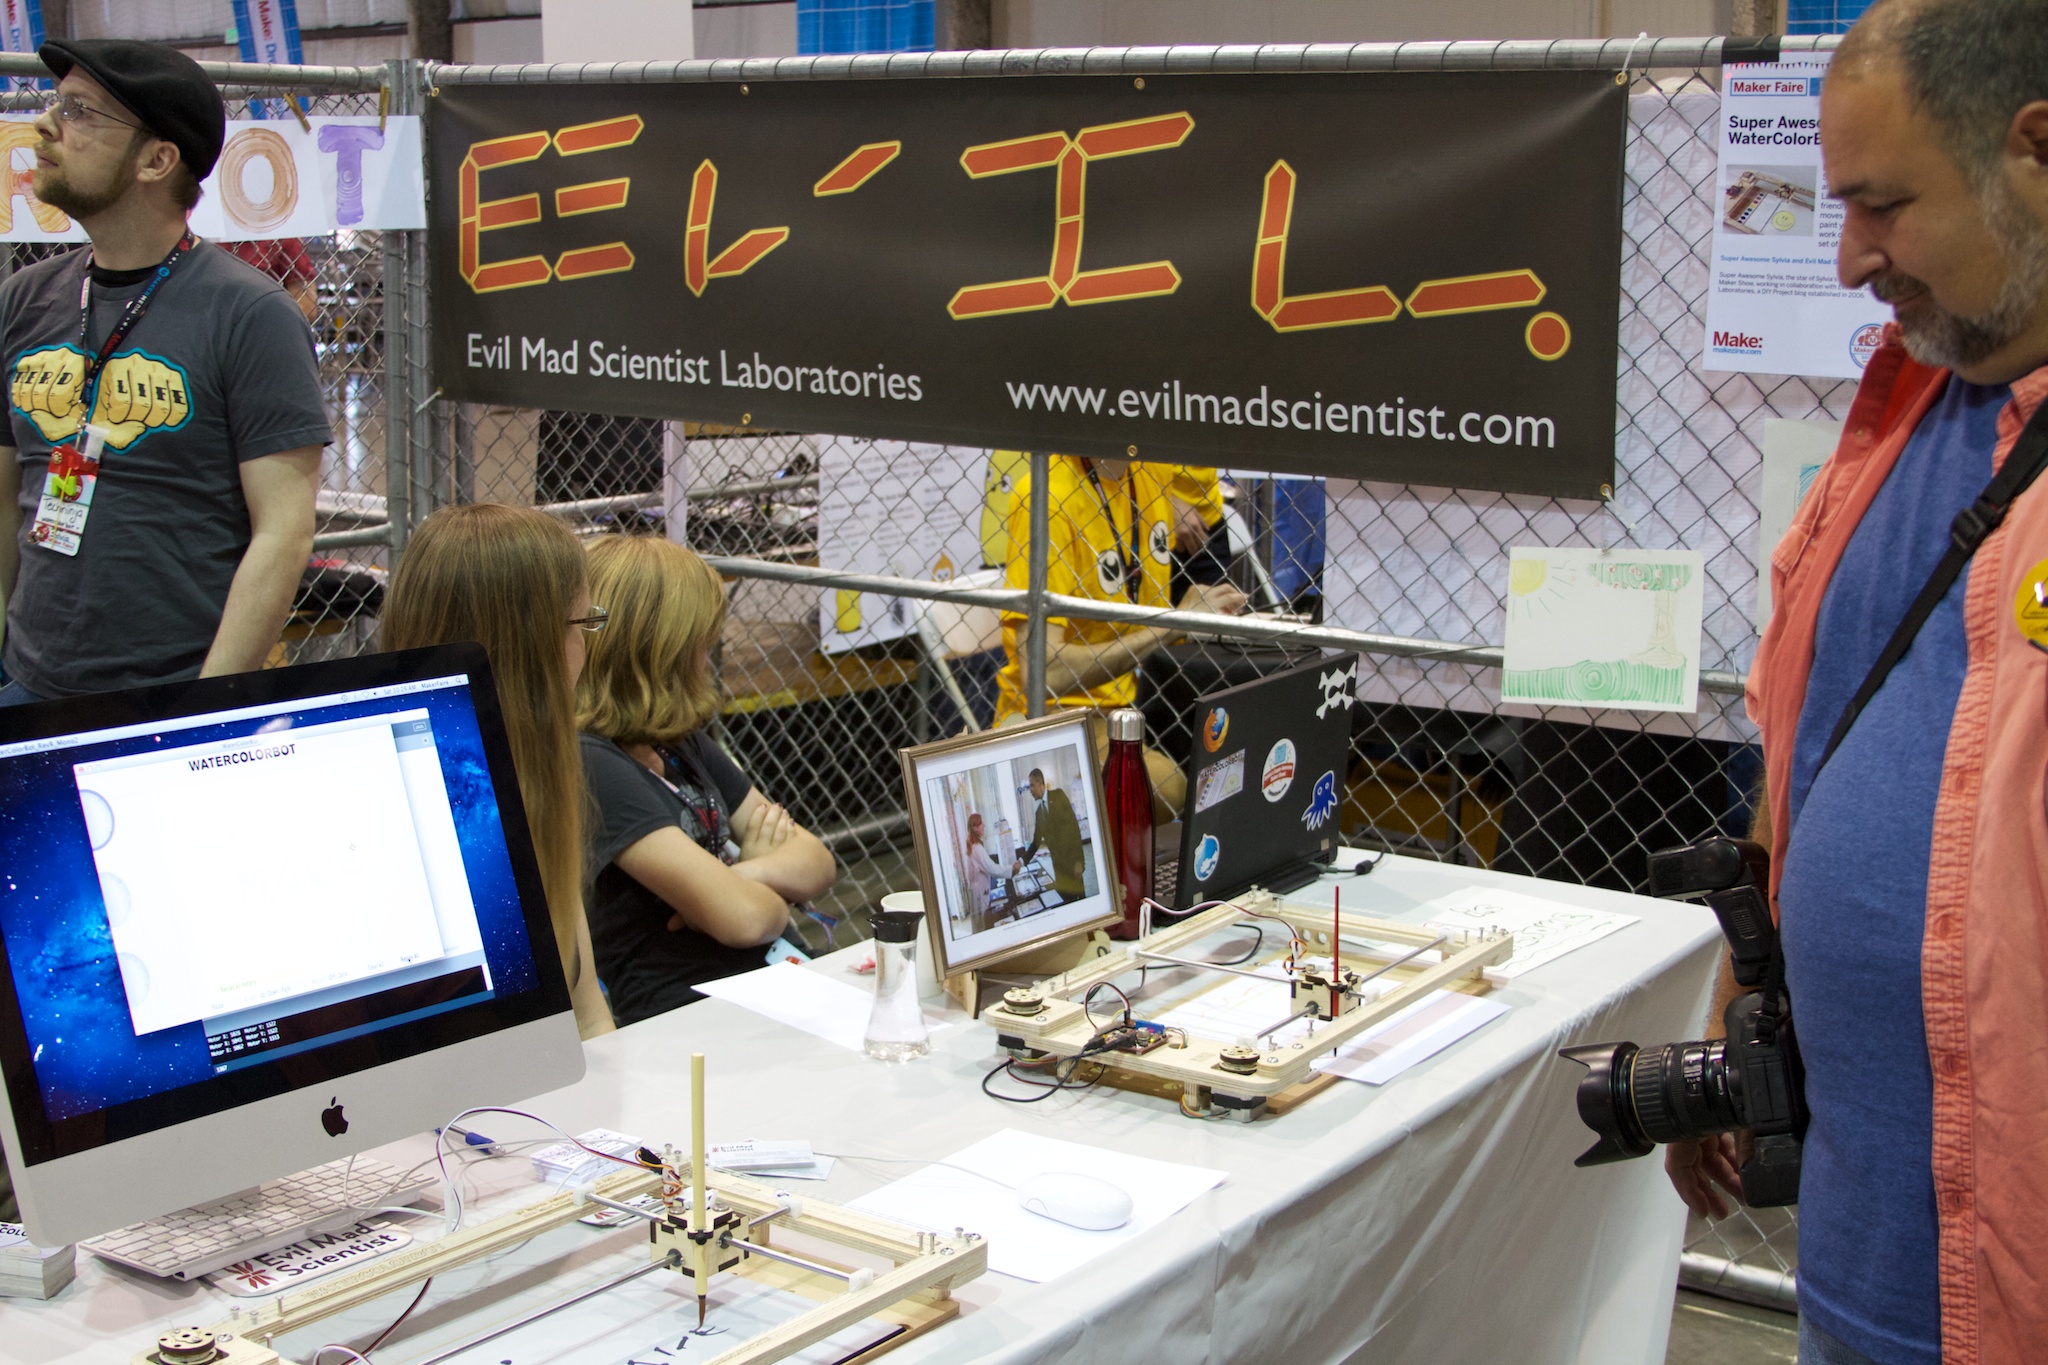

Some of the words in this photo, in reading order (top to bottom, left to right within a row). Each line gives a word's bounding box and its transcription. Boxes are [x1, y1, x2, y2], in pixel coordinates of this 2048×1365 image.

[257, 1, 273, 41] Make:
[1733, 81, 1769, 93] Maker
[1774, 82, 1804, 93] Faire
[1729, 115, 1774, 131] Super
[1819, 212, 1844, 220] moves
[1819, 221, 1838, 230] paint
[1818, 230, 1836, 238] work
[1818, 239, 1830, 248] set
[1830, 239, 1839, 248] of
[1771, 256, 1791, 264] Sylvia
[1805, 257, 1816, 265] Evil
[1719, 271, 1737, 279] Super
[1718, 279, 1737, 287] Maker
[1756, 281, 1779, 289] working
[1786, 281, 1824, 290] collaboration
[1773, 289, 1794, 297] Project
[1794, 290, 1807, 298] blog
[1713, 331, 1763, 349] Make:
[1712, 347, 1762, 355] makezine.com
[467, 333, 511, 370] Evil
[521, 336, 579, 375] Mad
[589, 340, 711, 384] Scientist
[720, 350, 924, 402] Laboratories
[116, 379, 187, 406] LIFE
[1006, 379, 1556, 449] www.evilmadscientist.com
[187, 743, 297, 772] WATERCOLORBOT
[252, 1243, 312, 1268] Evil
[308, 1221, 376, 1249] Mad
[276, 1232, 398, 1278] Scientist
